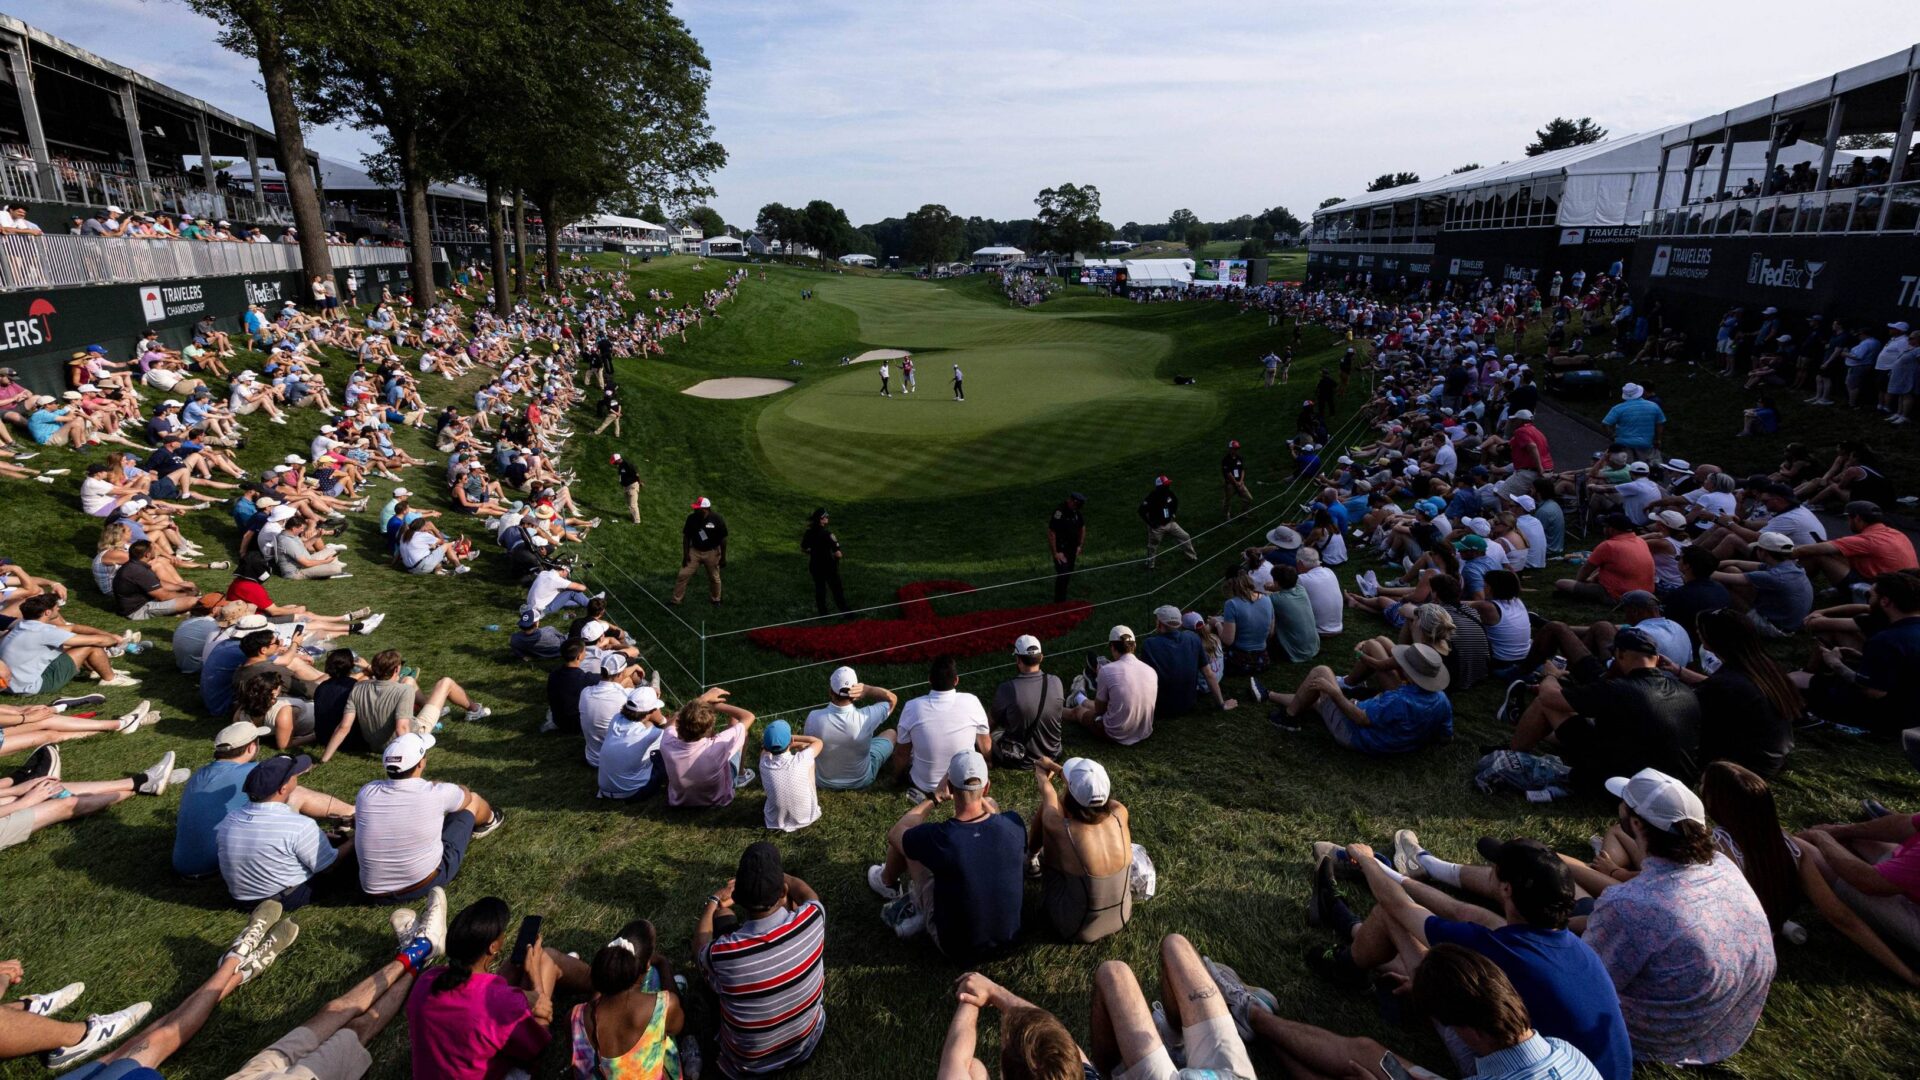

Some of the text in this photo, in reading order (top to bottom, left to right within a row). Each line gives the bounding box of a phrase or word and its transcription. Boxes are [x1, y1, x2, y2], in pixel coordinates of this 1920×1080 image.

[1672, 248, 1712, 264] TRAVELERS
[1758, 258, 1804, 288] FedEx
[162, 285, 203, 303] TRAVELERS
[167, 302, 206, 316] CHAMPIONSHIP
